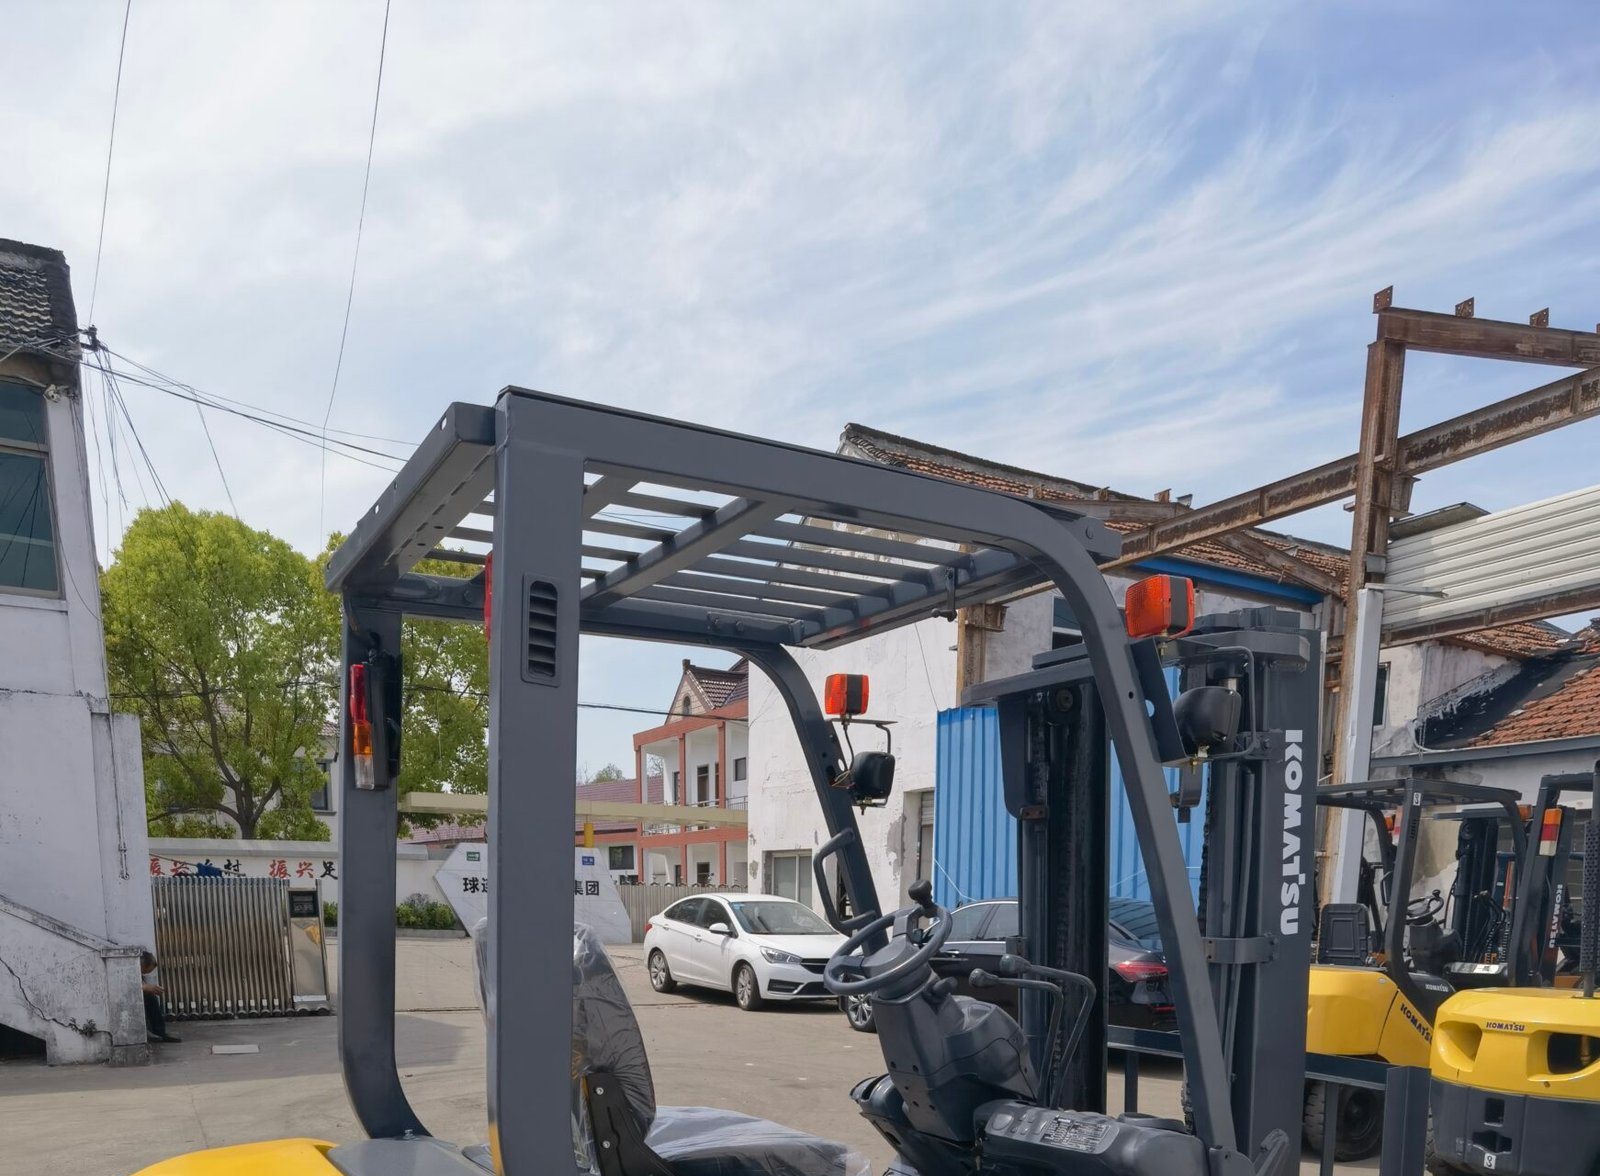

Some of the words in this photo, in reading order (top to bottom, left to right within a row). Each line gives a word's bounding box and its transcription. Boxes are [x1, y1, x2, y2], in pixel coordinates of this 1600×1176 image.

[1280, 730, 1306, 936] KOMATSU
[150, 858, 243, 877] 振兴村
[1549, 884, 1563, 948] KOMATSU
[1425, 983, 1449, 992] KOMATSU
[1400, 1003, 1433, 1044] KOMATS
[1486, 1021, 1525, 1032] KOMATSU
